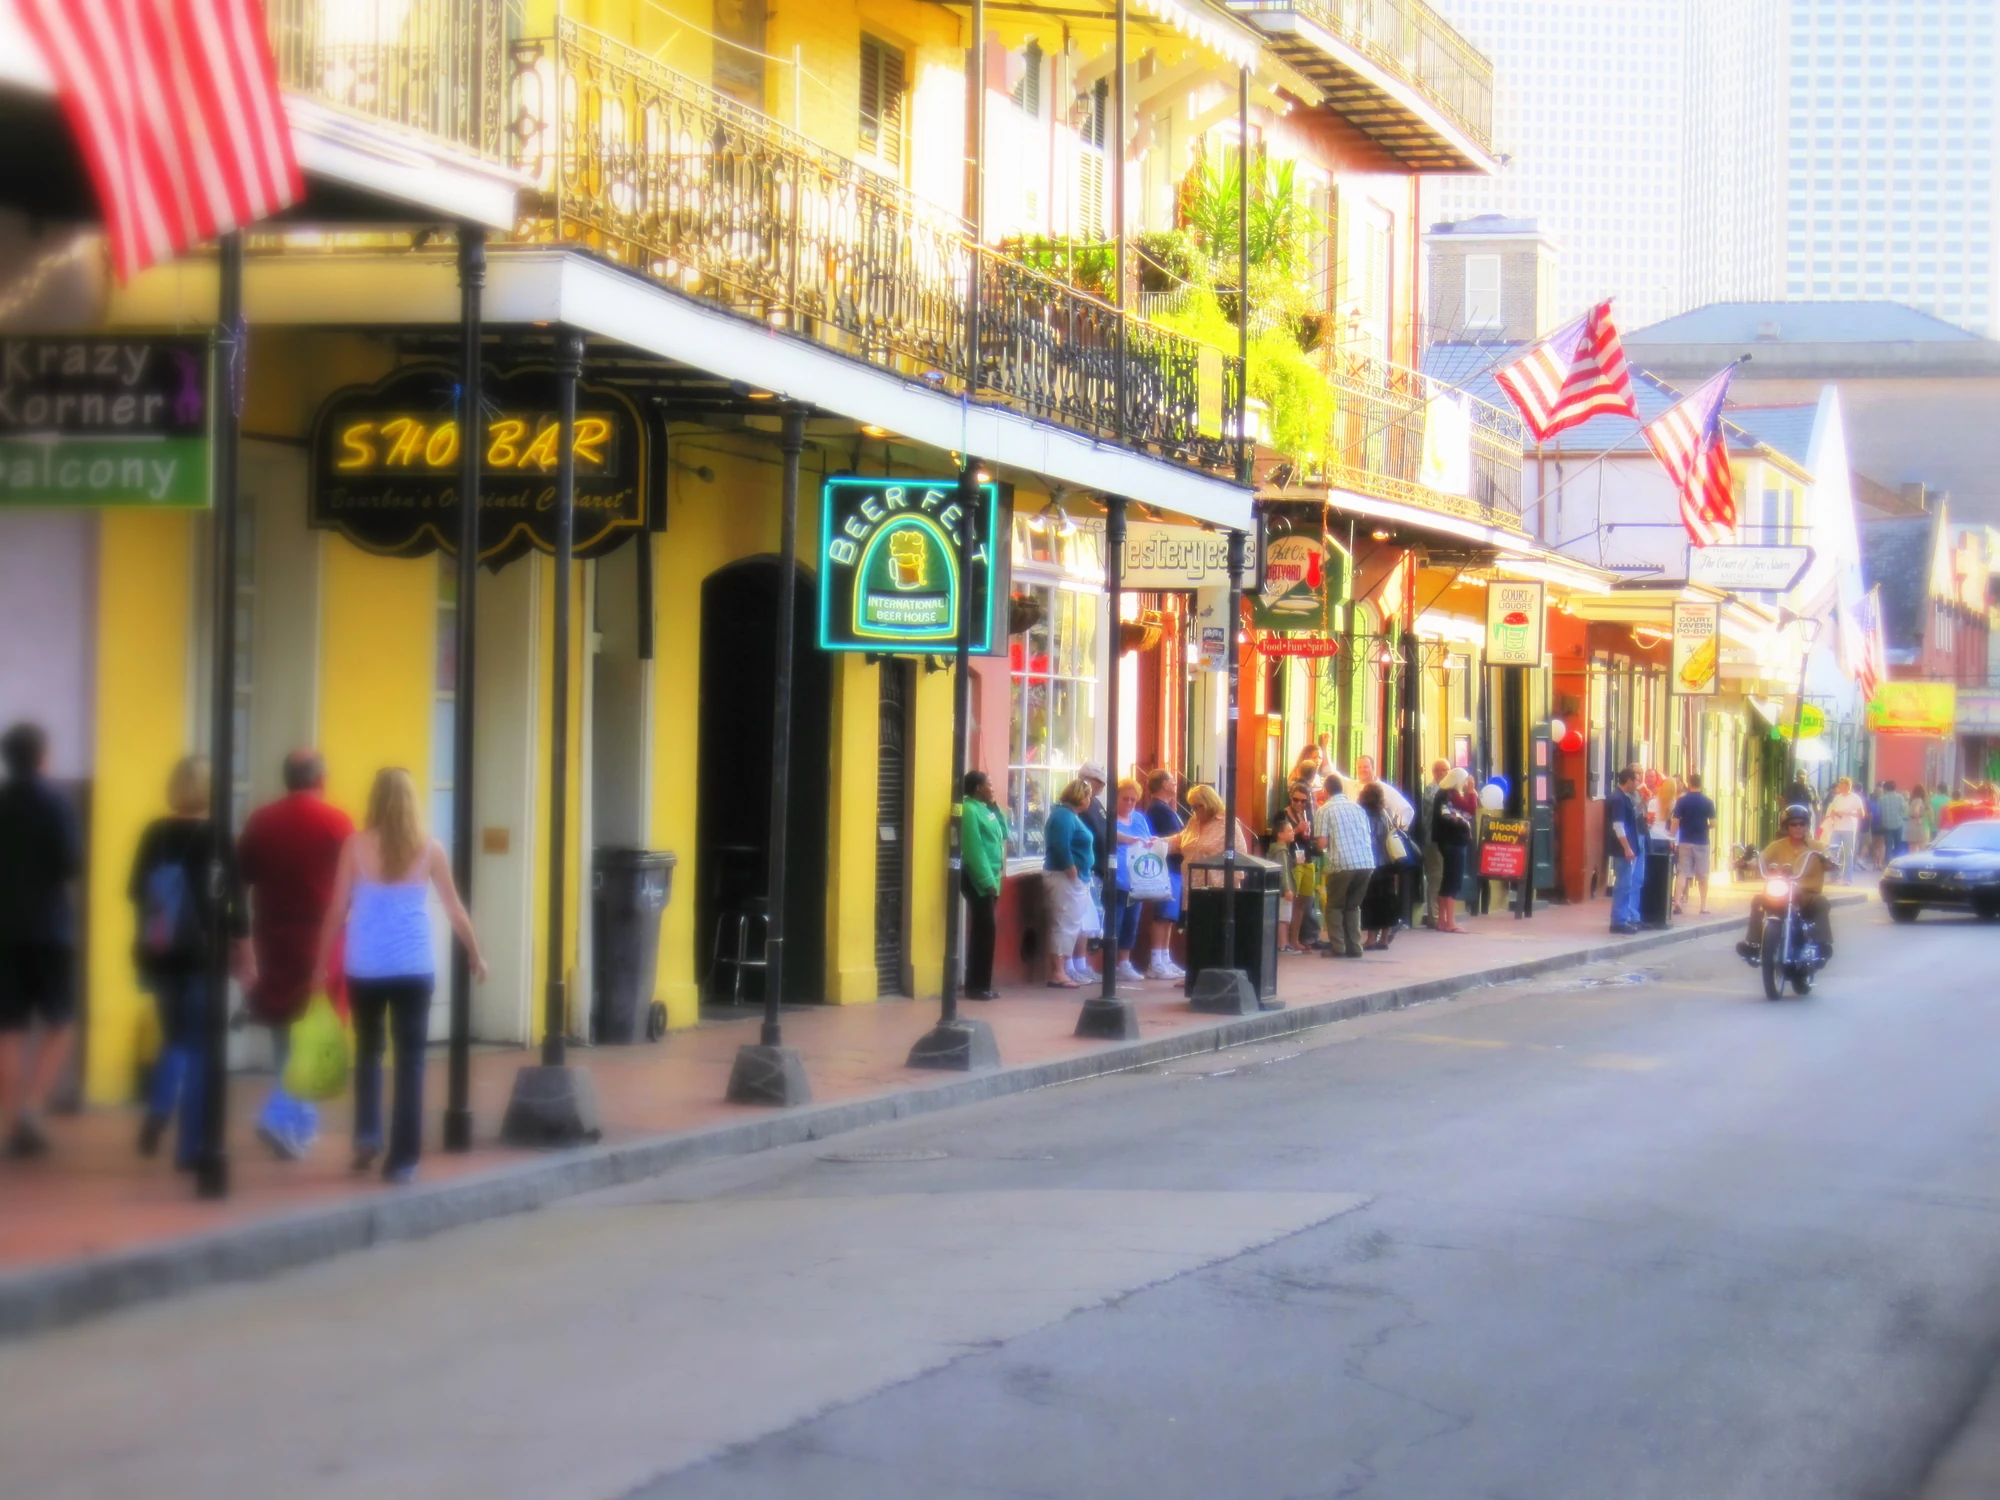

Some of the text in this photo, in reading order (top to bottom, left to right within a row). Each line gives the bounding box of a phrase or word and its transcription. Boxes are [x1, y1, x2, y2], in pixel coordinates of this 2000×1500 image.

[4, 340, 150, 385] Krazy
[338, 418, 611, 467] SHO BAR
[0, 435, 177, 499] alcony
[829, 486, 908, 566] BEER
[1119, 531, 1256, 579] esteryeas
[1501, 588, 1529, 602] COURT
[868, 597, 945, 609] INTERNATIONAL
[1498, 602, 1532, 610] LIQUORS
[876, 610, 937, 622] BEER HOUSE
[1262, 641, 1283, 651] Food
[1287, 642, 1302, 652] Fun
[1489, 822, 1522, 833] Bloody
[1492, 833, 1518, 844] Mary
